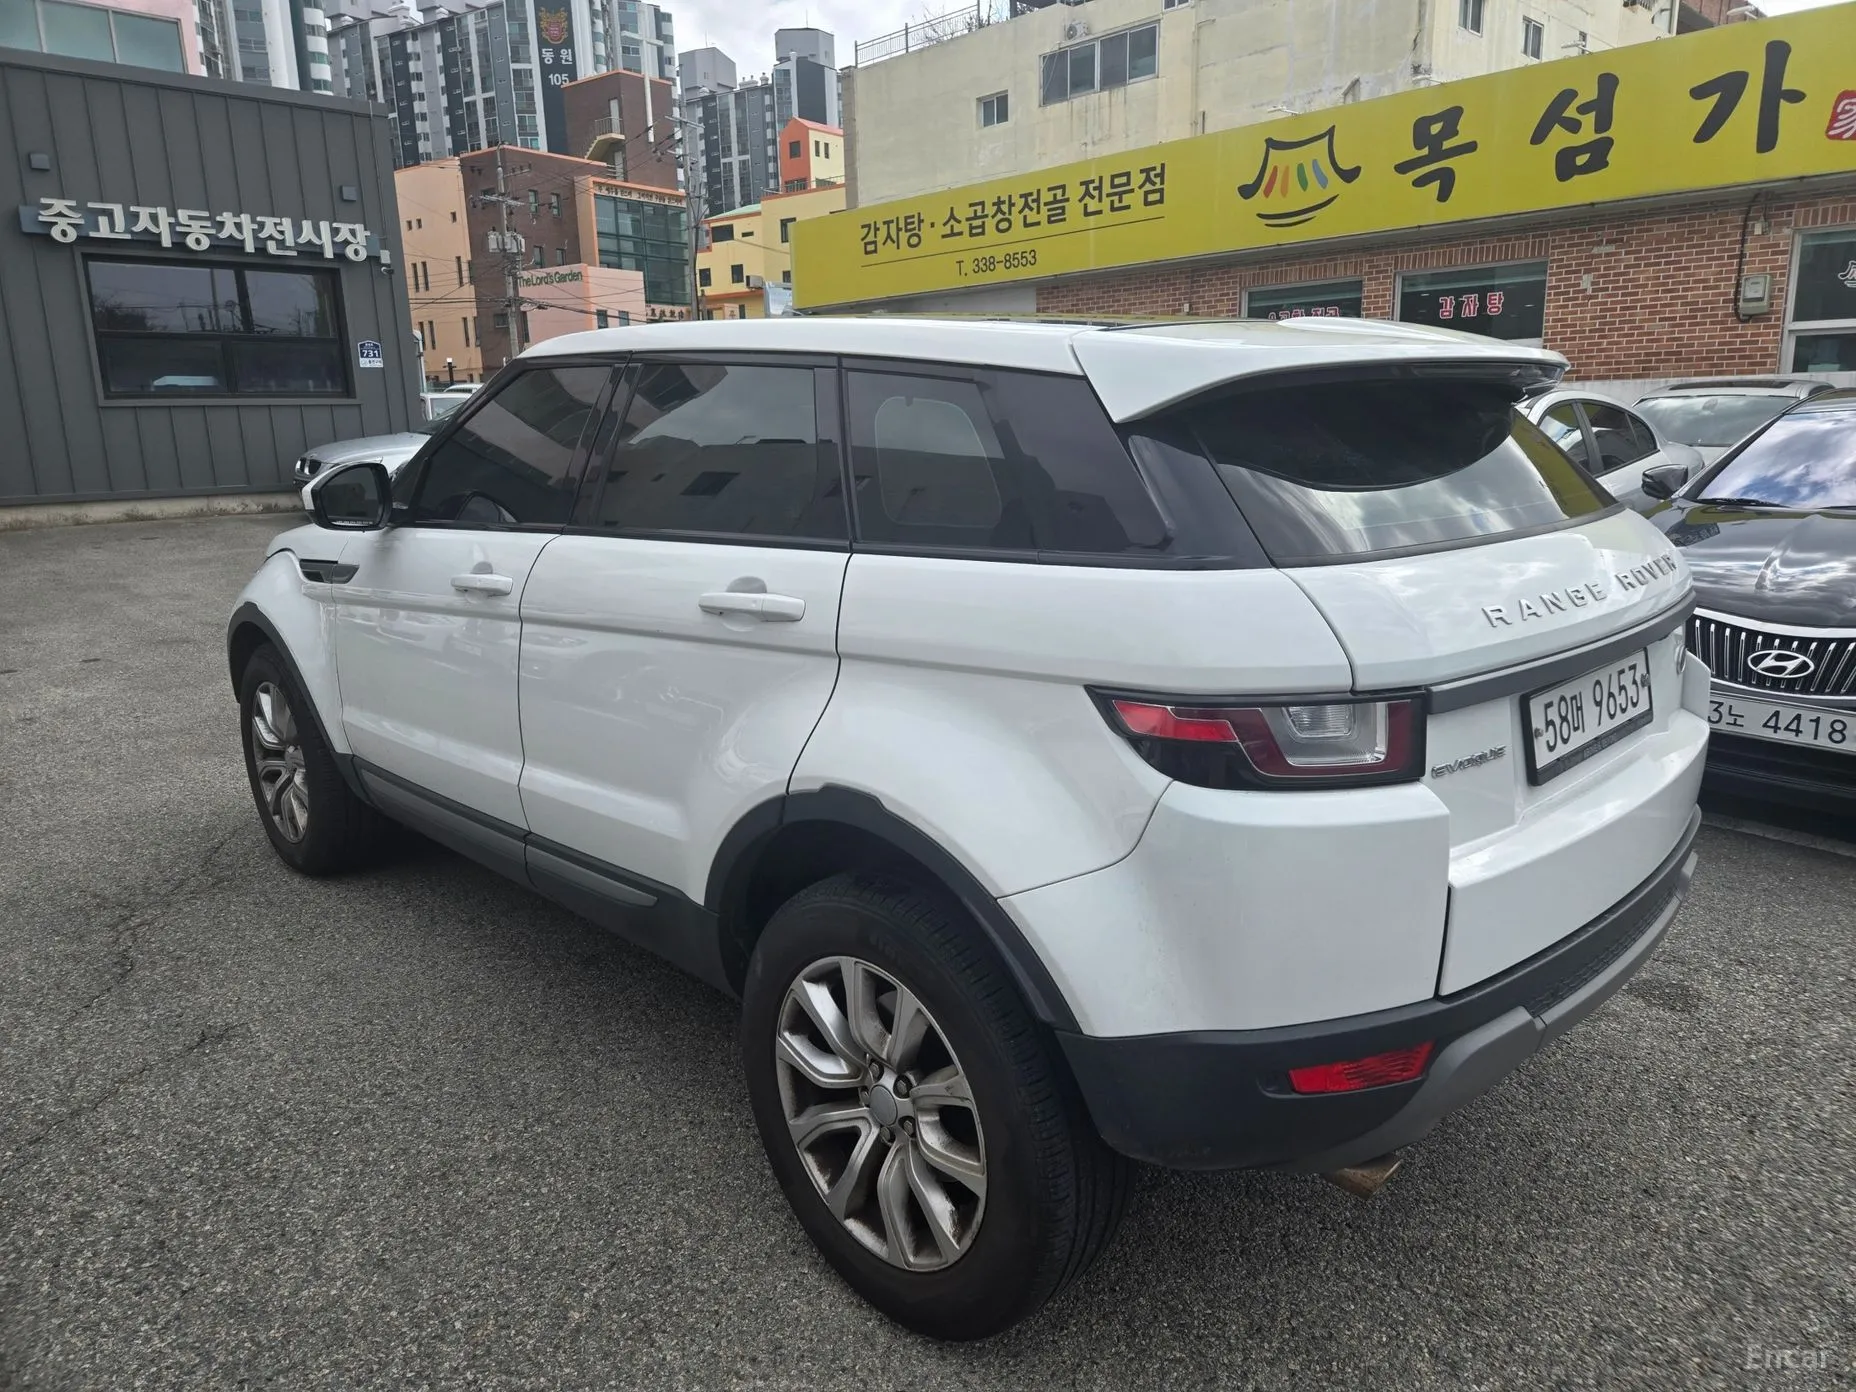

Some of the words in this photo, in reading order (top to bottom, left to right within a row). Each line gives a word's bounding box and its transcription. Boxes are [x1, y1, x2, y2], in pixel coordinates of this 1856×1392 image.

[541, 48, 573, 65] 동원
[548, 73, 570, 87] 105
[1078, 162, 1166, 218] 전문점
[38, 196, 371, 263] 중고자동차전시장
[554, 269, 583, 284] Garden
[956, 259, 967, 276] T.
[972, 249, 1037, 274] 338-8553
[1439, 291, 1505, 319] 감자탕
[362, 349, 379, 358] 731
[1481, 582, 1609, 628] RANGE
[1615, 553, 1678, 592] ROVER
[1543, 690, 1586, 753] 58머
[1592, 662, 1640, 727] 9653
[1761, 709, 1848, 744] 4418
